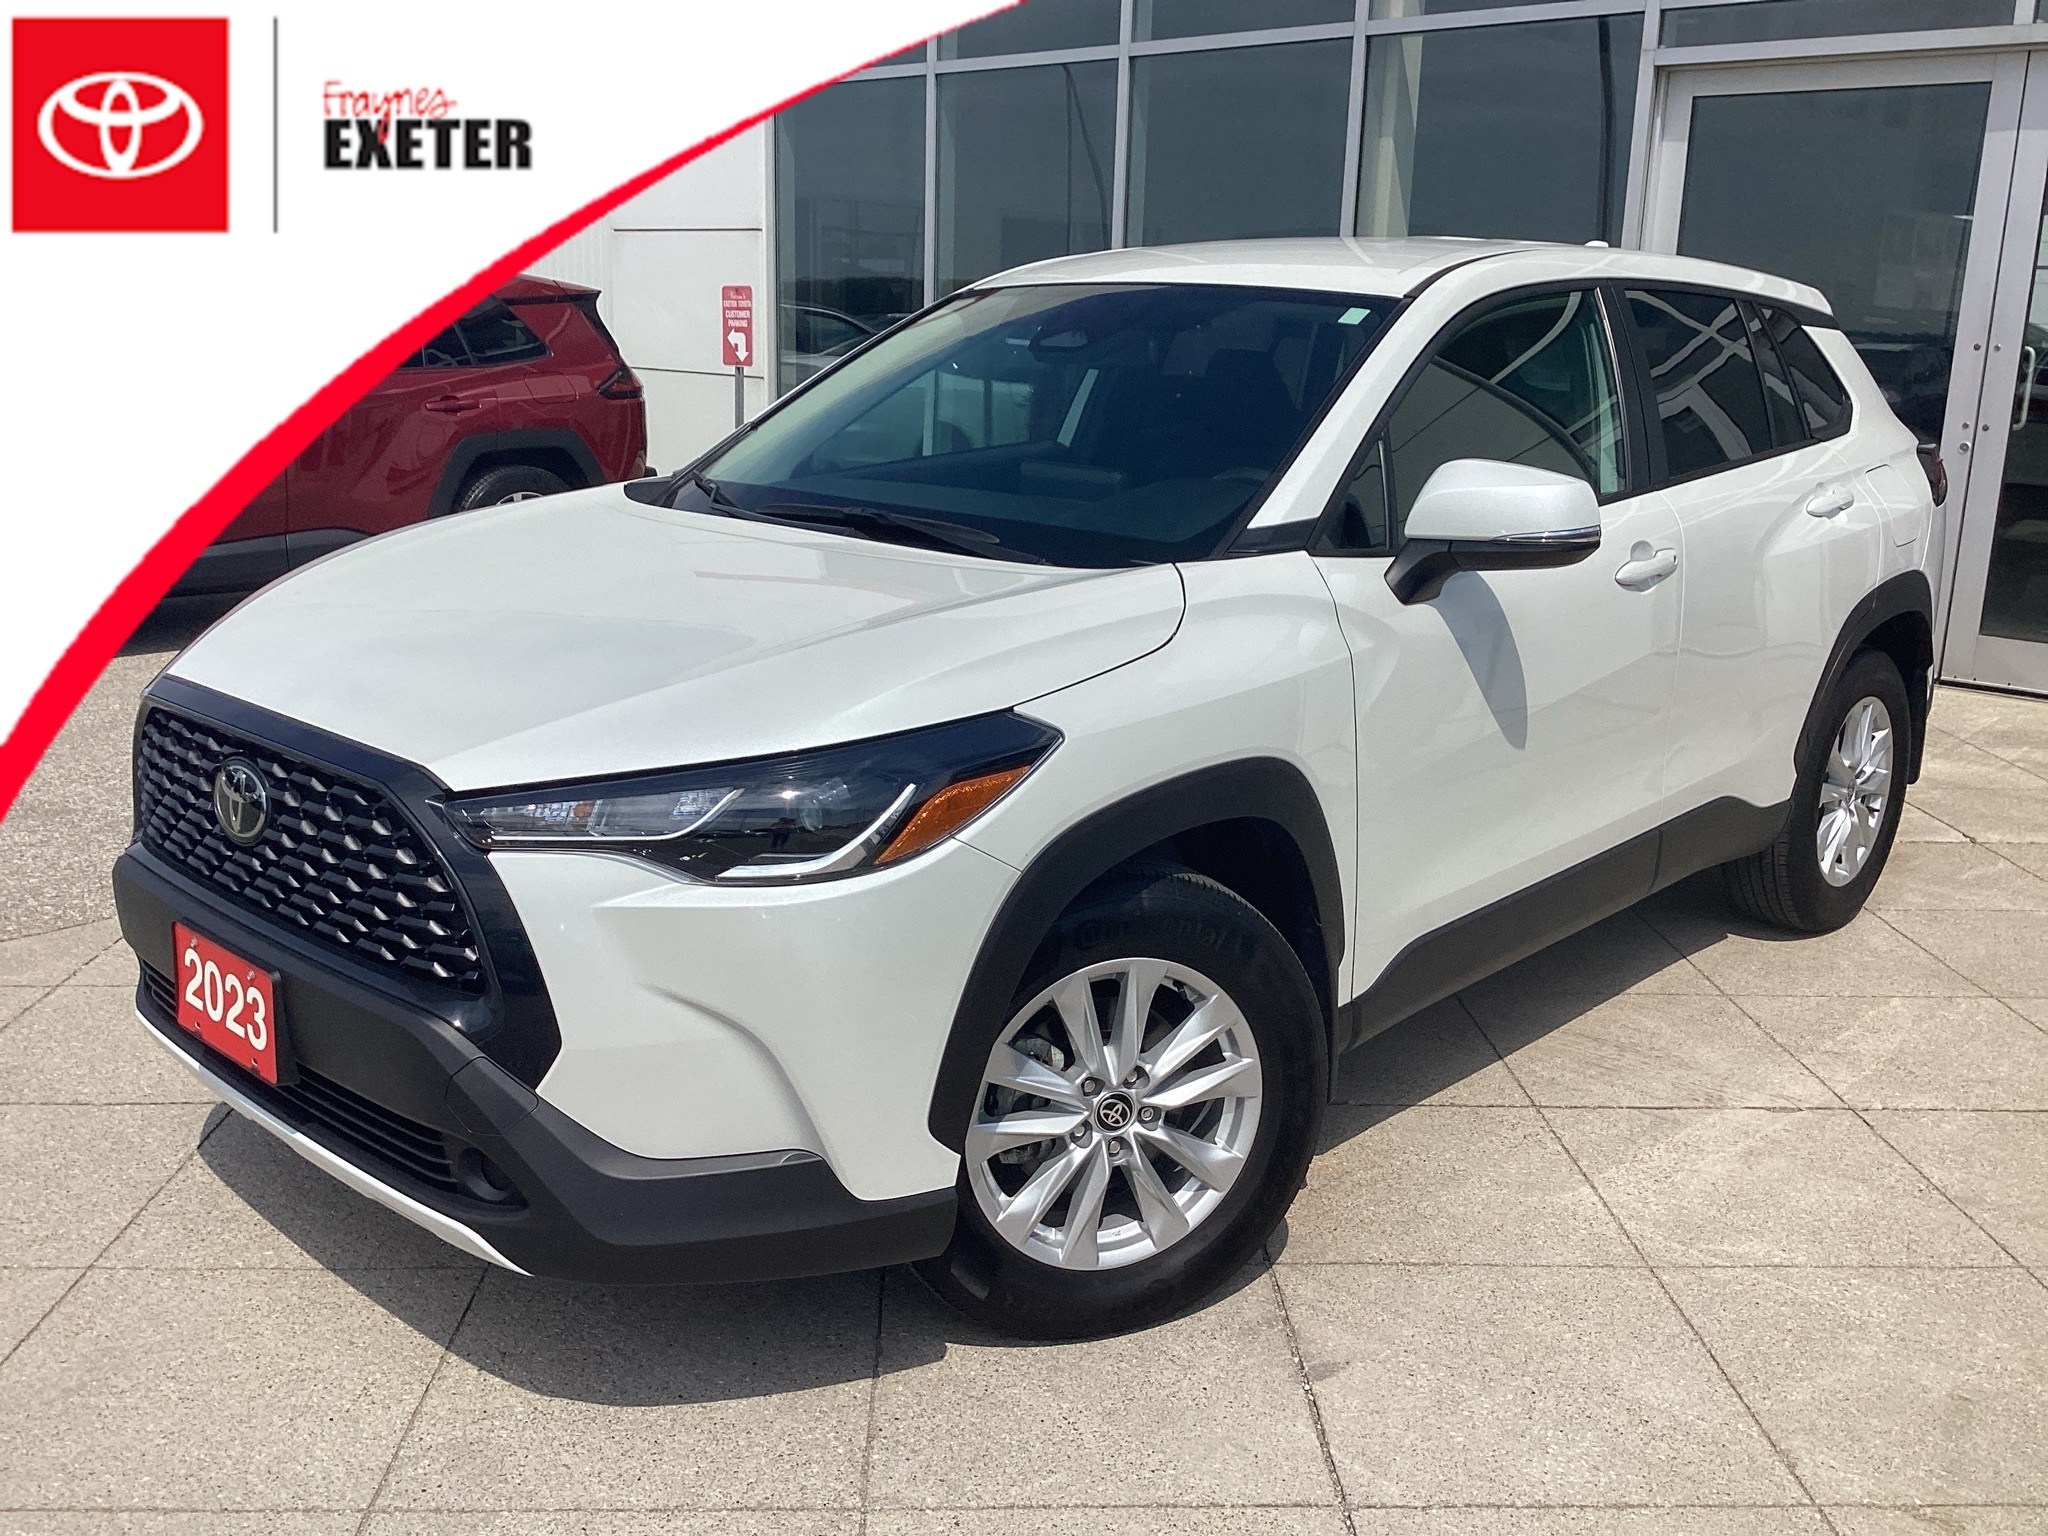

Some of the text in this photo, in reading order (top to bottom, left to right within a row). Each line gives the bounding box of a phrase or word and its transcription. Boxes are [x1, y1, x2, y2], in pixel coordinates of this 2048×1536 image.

[725, 310, 751, 318] CUSTOMER
[728, 319, 748, 328] PARKING
[184, 948, 268, 1051] 2023
